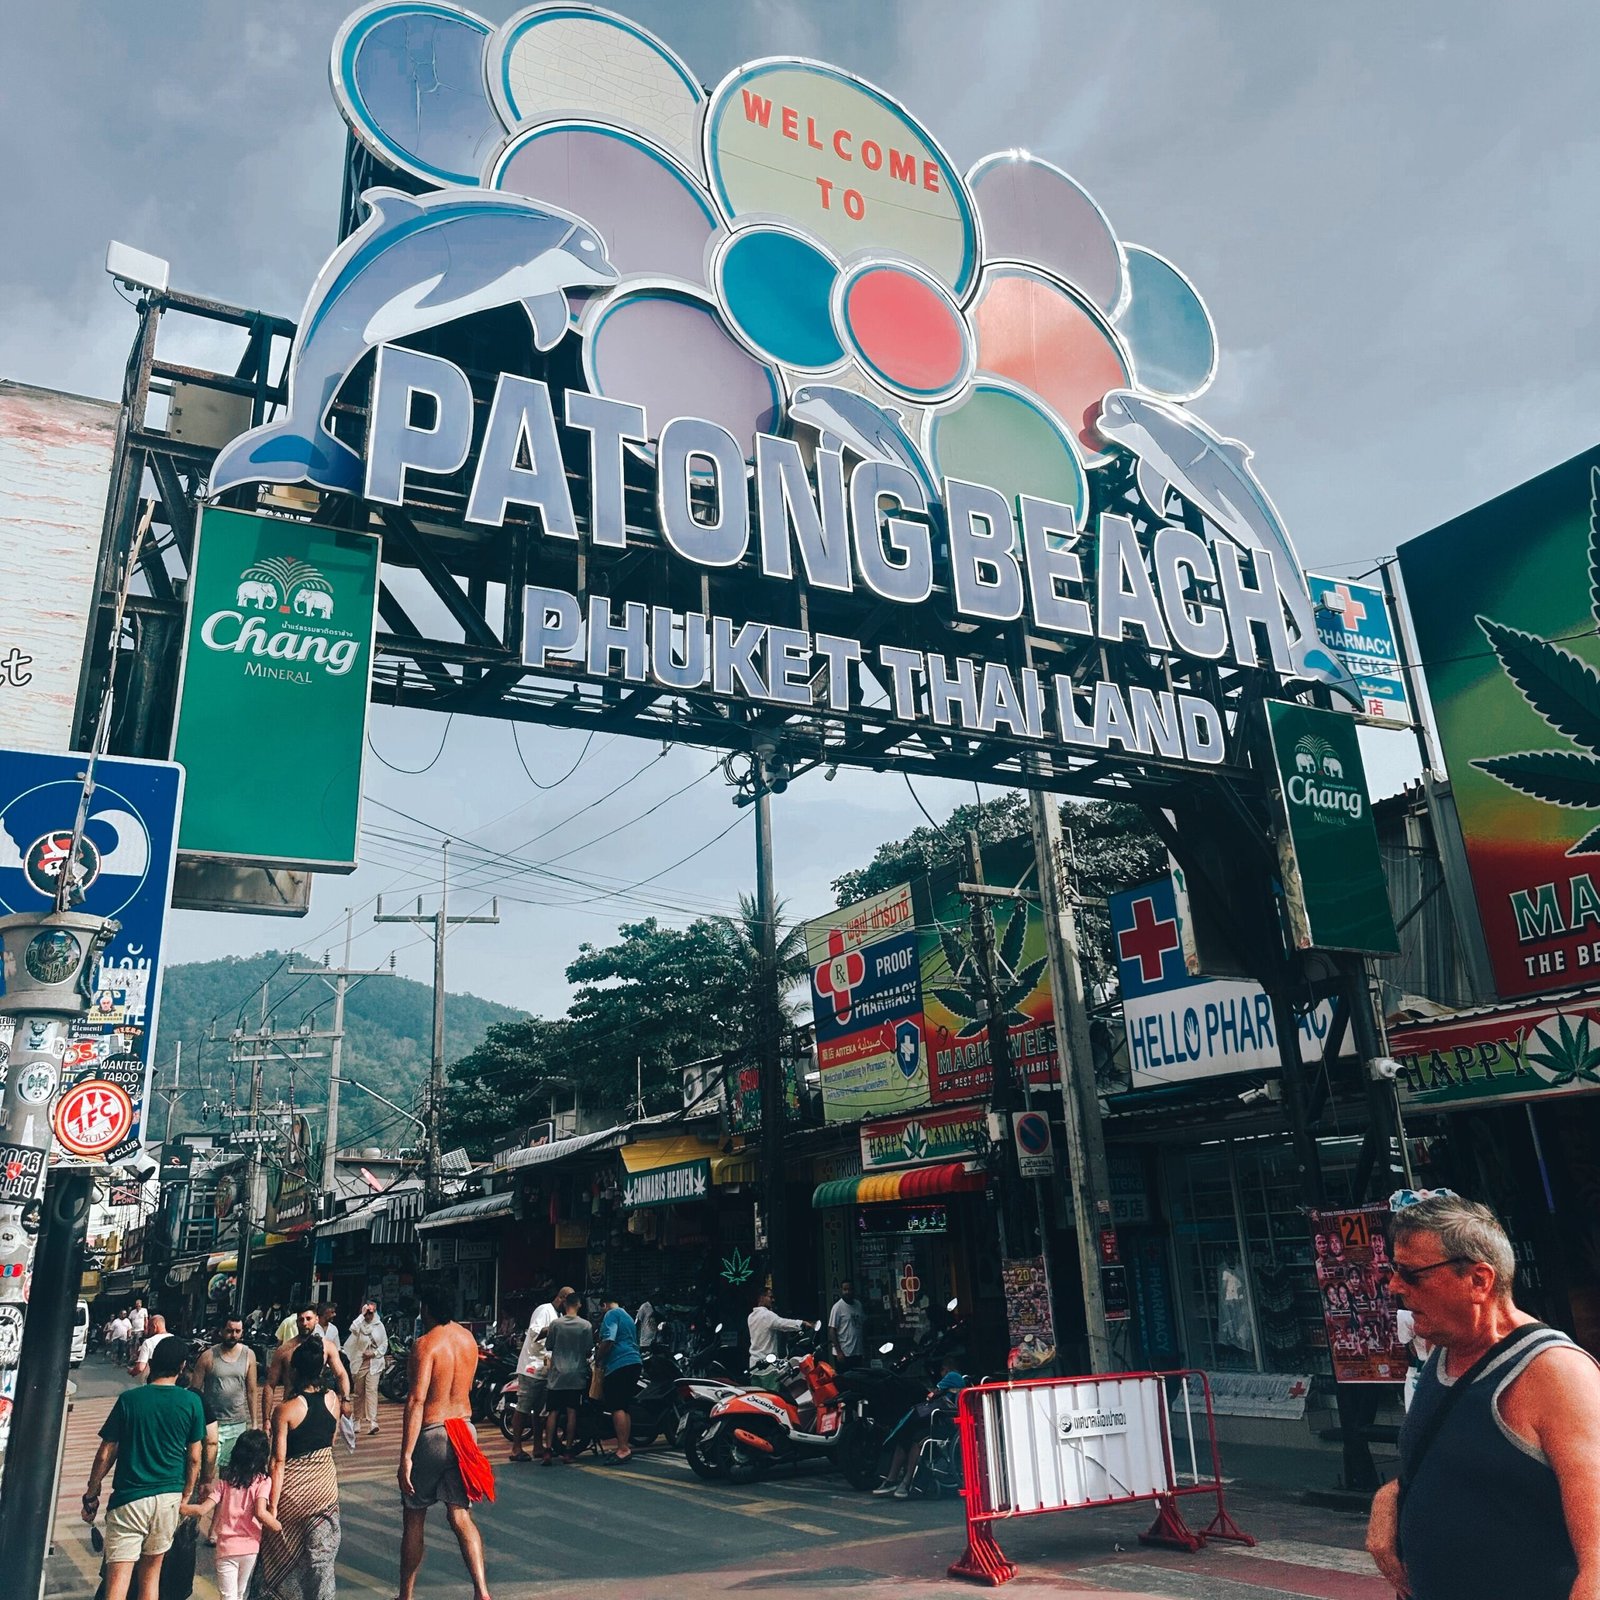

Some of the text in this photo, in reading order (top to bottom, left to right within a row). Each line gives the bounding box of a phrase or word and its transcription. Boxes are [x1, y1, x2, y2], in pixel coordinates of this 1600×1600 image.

[741, 88, 940, 194] WELCOME
[816, 176, 866, 221] TO
[364, 343, 1297, 675] PATONG BEACH
[201, 610, 361, 677] Chang
[521, 585, 861, 711] PHUKET
[1287, 775, 1362, 819] Chang
[876, 947, 913, 978] PROOF
[1525, 950, 1565, 977] THE
[855, 980, 917, 1019] PHARMACY
[1129, 1007, 1201, 1071] HELLO
[1396, 1026, 1533, 1092] HAPPY
[100, 1060, 144, 1072] WANTED
[103, 1070, 139, 1083] TABOO
[869, 1133, 904, 1158] HAPPY
[633, 1166, 694, 1205] CANNABIS HEAVEN
[1342, 1215, 1366, 1246] 21
